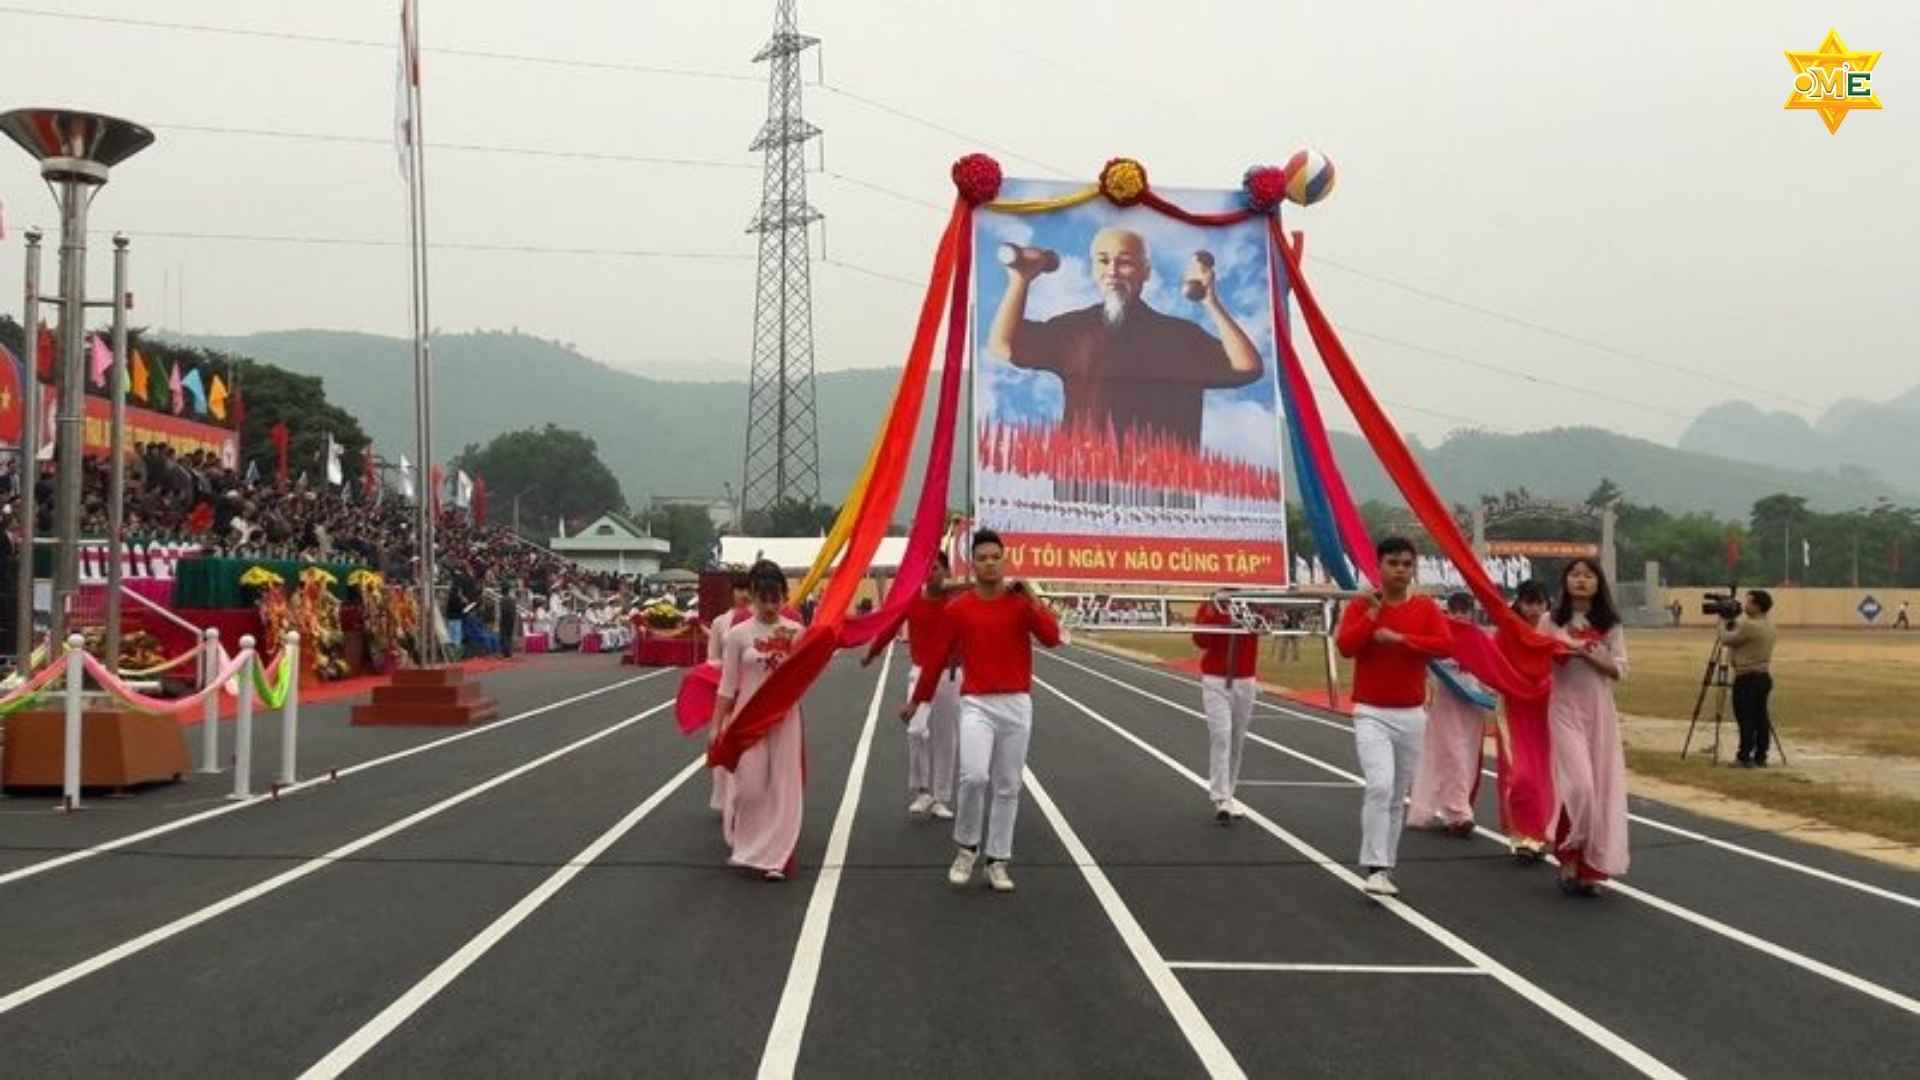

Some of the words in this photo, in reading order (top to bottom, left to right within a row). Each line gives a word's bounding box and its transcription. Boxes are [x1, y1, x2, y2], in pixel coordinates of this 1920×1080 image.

[1031, 542, 1062, 567] TÔI
[1068, 545, 1117, 569] NGÀY
[1125, 545, 1163, 571] NÀO
[1168, 547, 1220, 573] CŨNG
